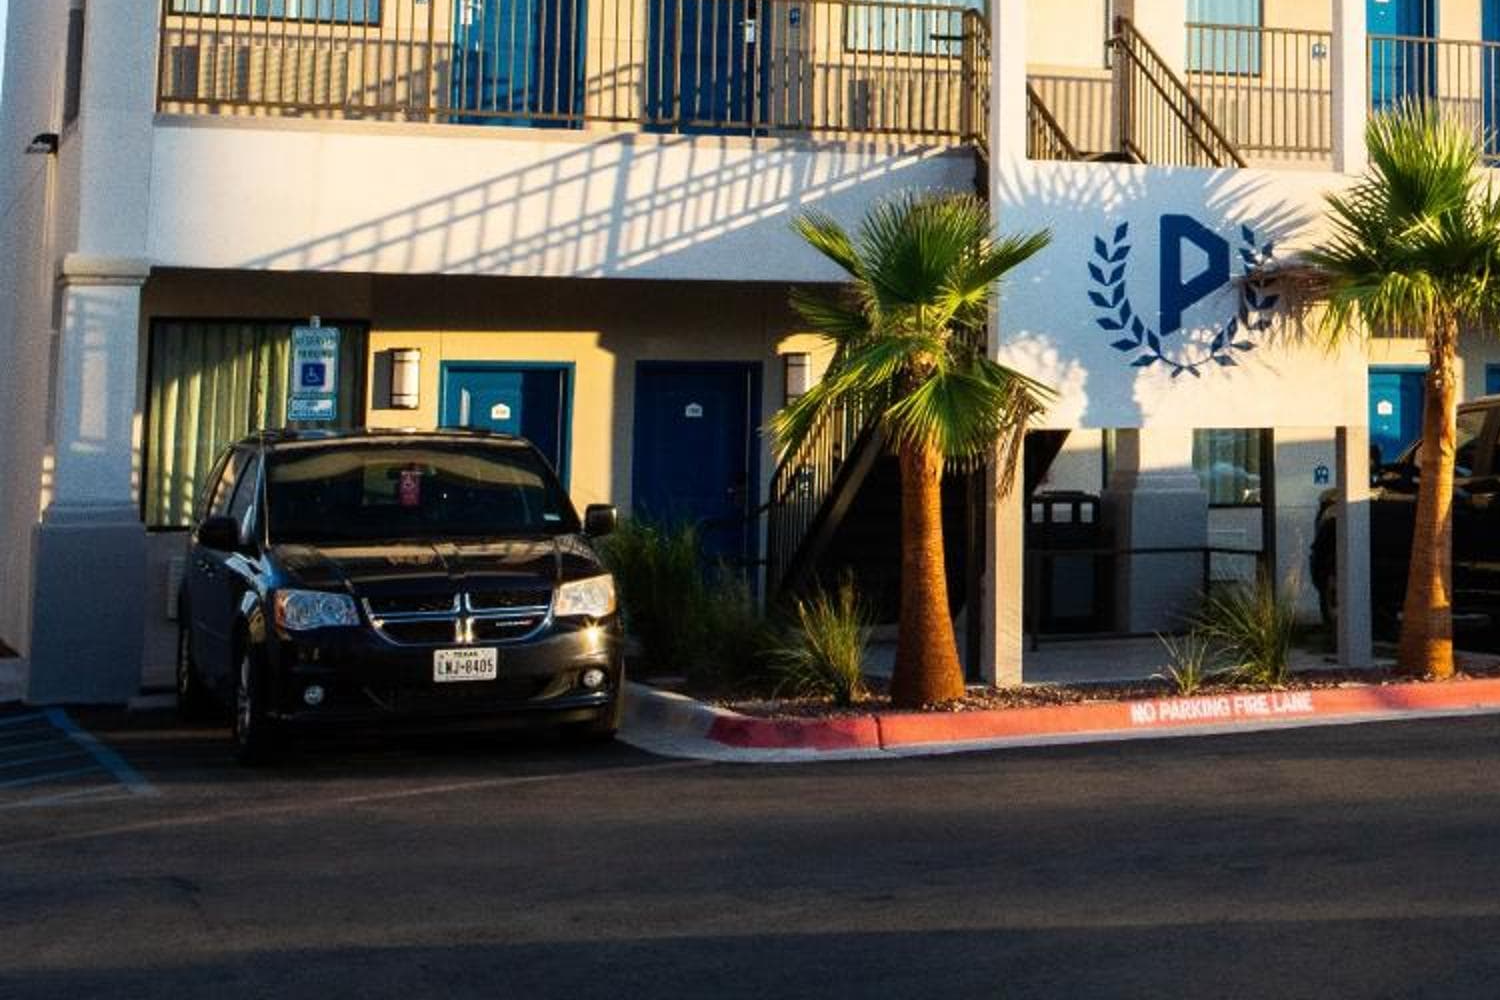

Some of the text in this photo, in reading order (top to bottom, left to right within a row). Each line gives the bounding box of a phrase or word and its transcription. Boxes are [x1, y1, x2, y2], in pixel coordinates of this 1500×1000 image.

[1160, 214, 1230, 336] P
[1131, 691, 1313, 724] NO PARKING FIRE LANE
